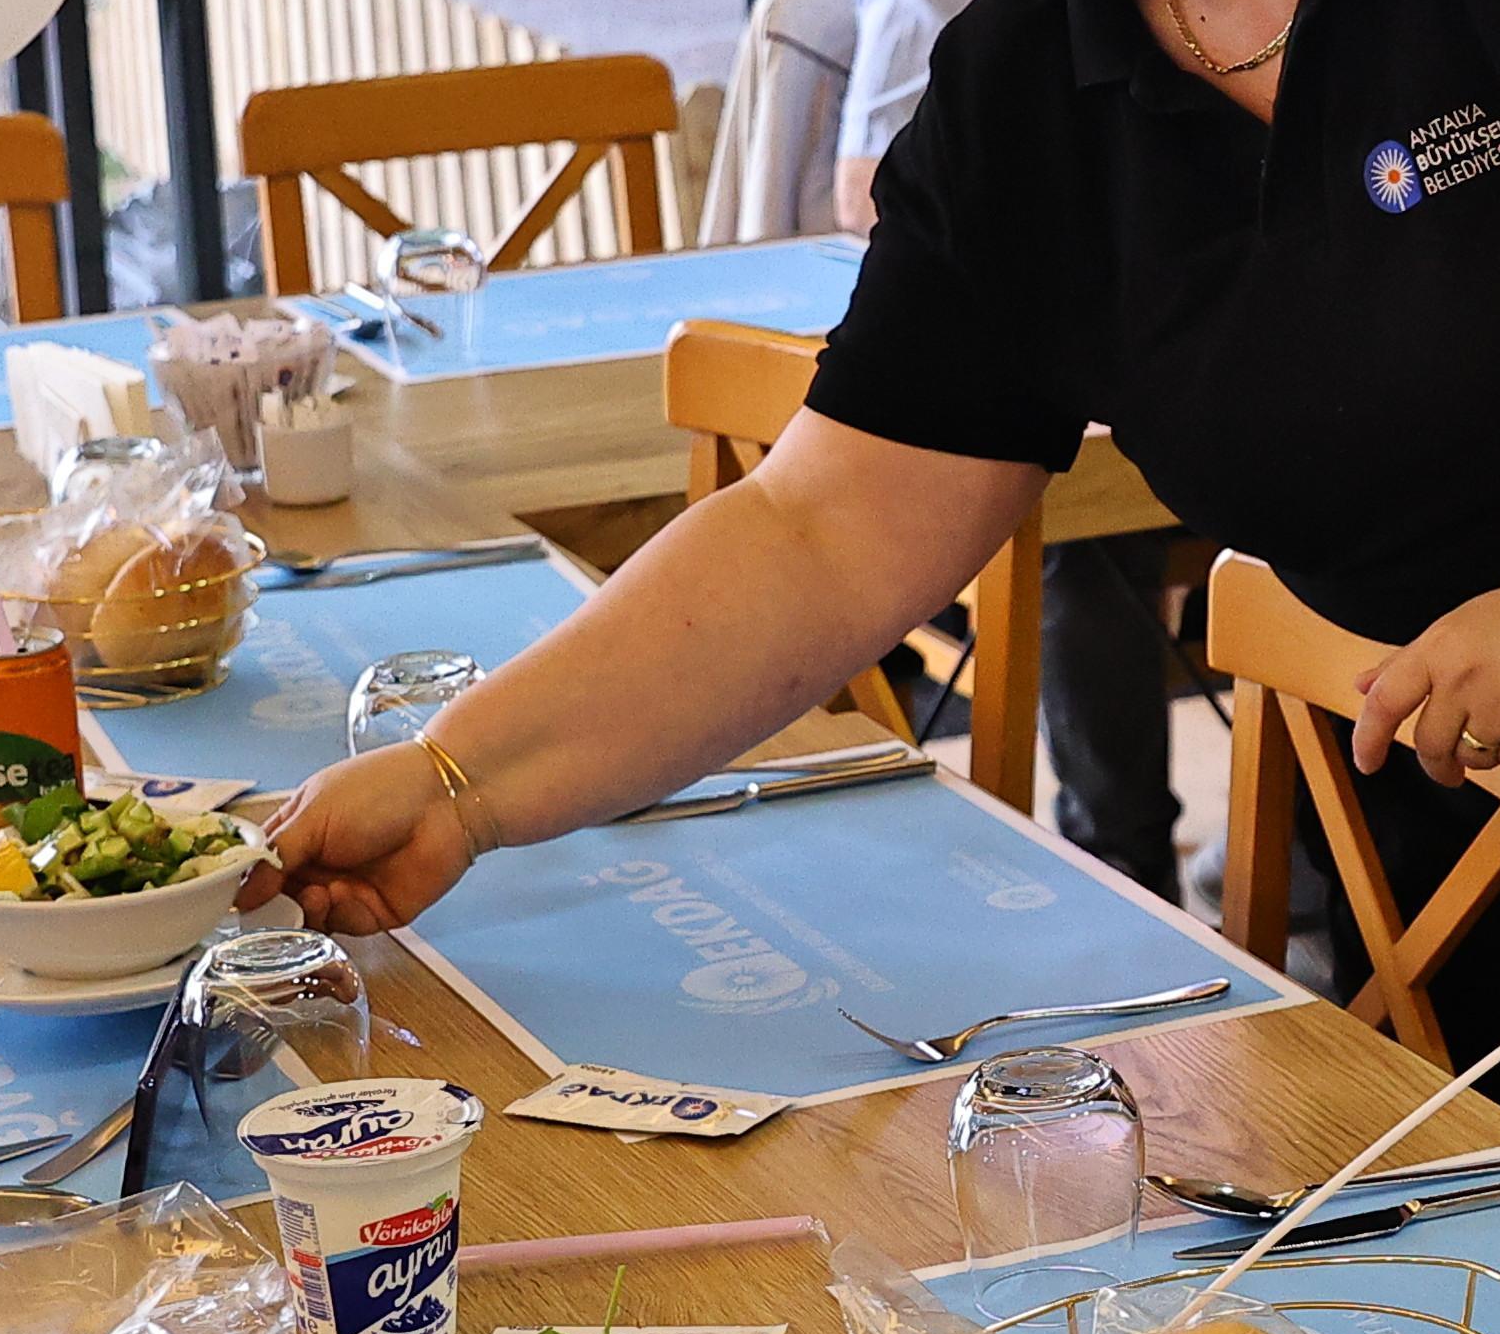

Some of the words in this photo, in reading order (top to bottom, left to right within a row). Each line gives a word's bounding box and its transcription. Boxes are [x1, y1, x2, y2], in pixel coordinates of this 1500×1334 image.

[1408, 103, 1486, 150] ANTALYA
[279, 1110, 414, 1152] ayran
[364, 1205, 453, 1243] Yörükoğlu
[368, 1229, 452, 1308] ayran
